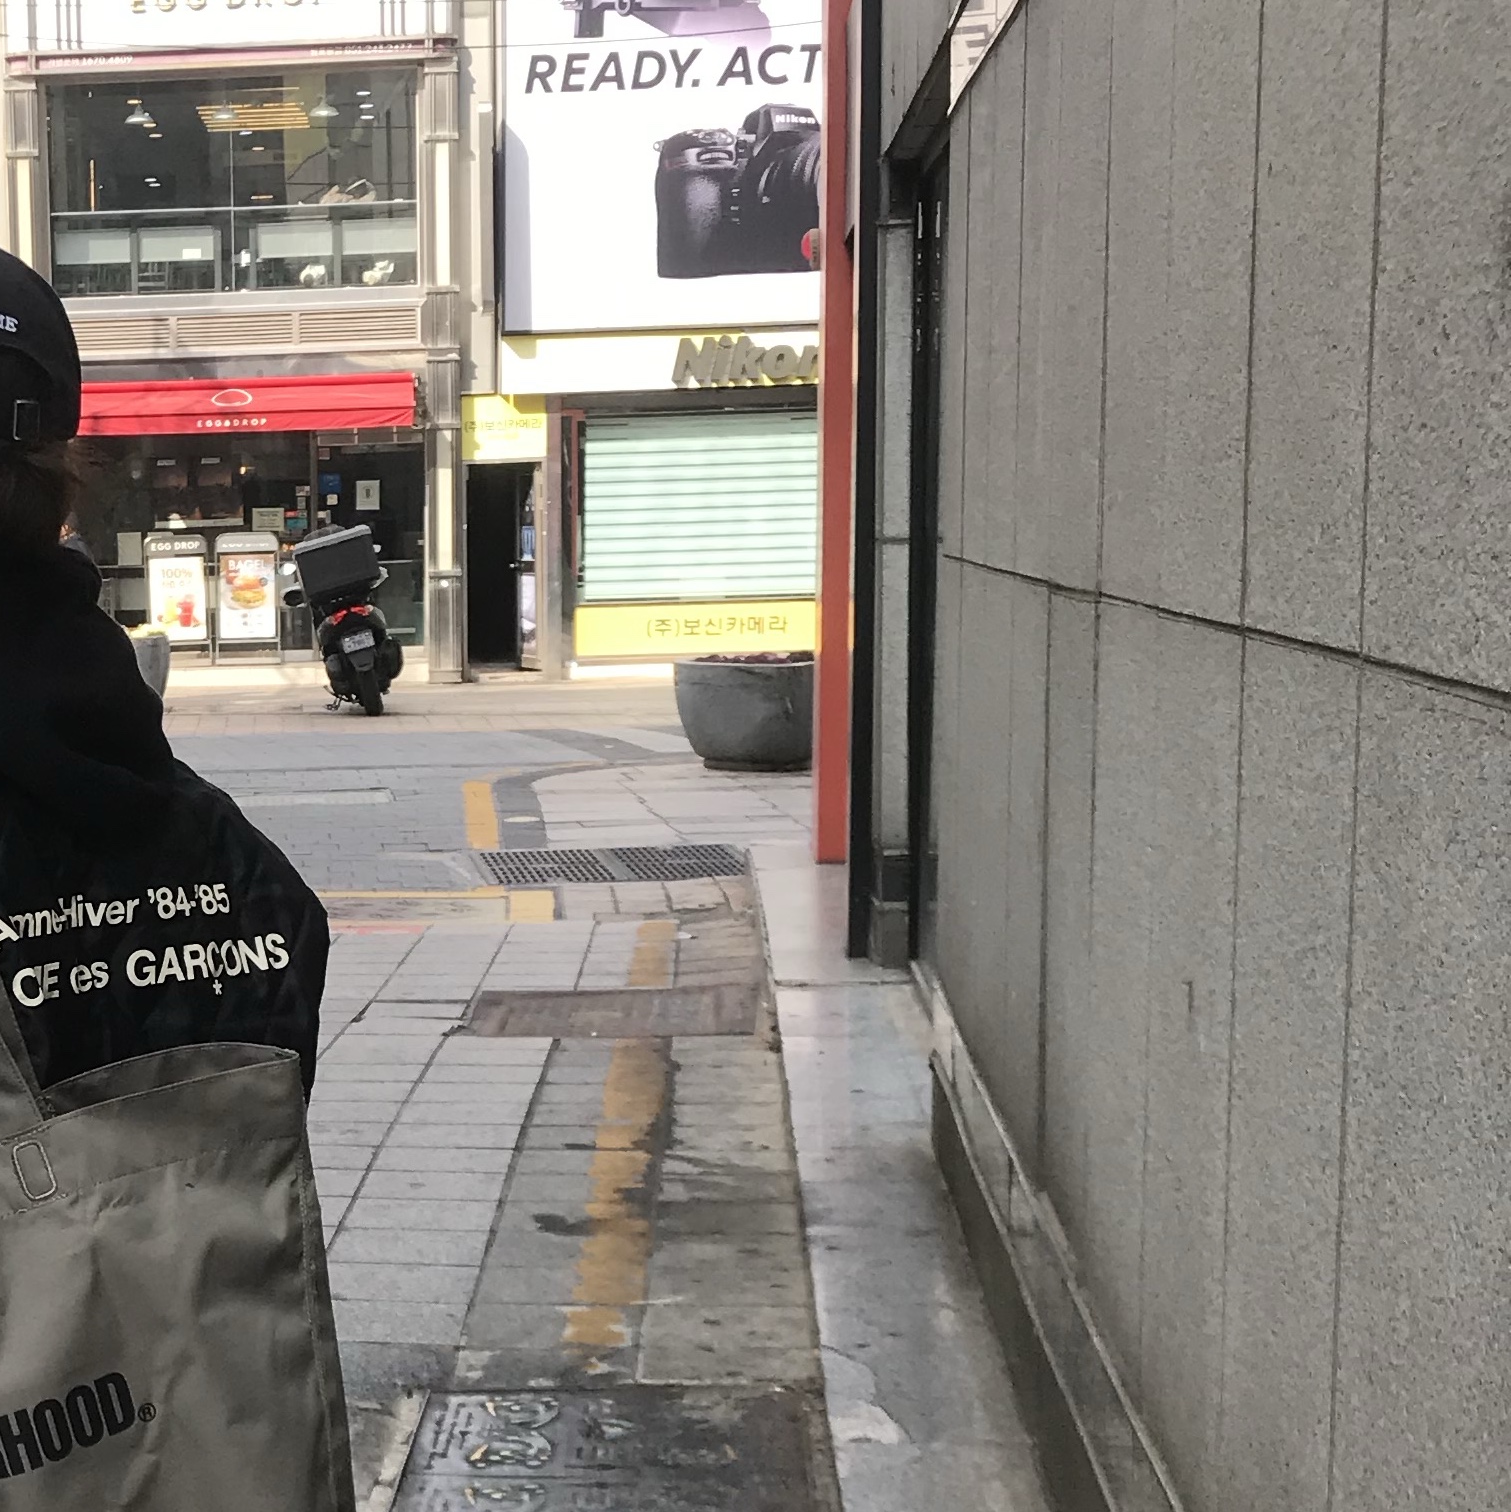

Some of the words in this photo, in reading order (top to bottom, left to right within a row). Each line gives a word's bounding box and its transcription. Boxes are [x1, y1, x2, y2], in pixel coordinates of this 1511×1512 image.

[524, 48, 703, 94] READY.
[716, 44, 822, 87] ACT
[775, 114, 816, 125] Nikon
[150, 541, 172, 551] EGG
[174, 540, 201, 551] DROP
[227, 559, 266, 571] BAGEL
[161, 568, 193, 579] 100%
[646, 615, 789, 638] (주)보신카메라
